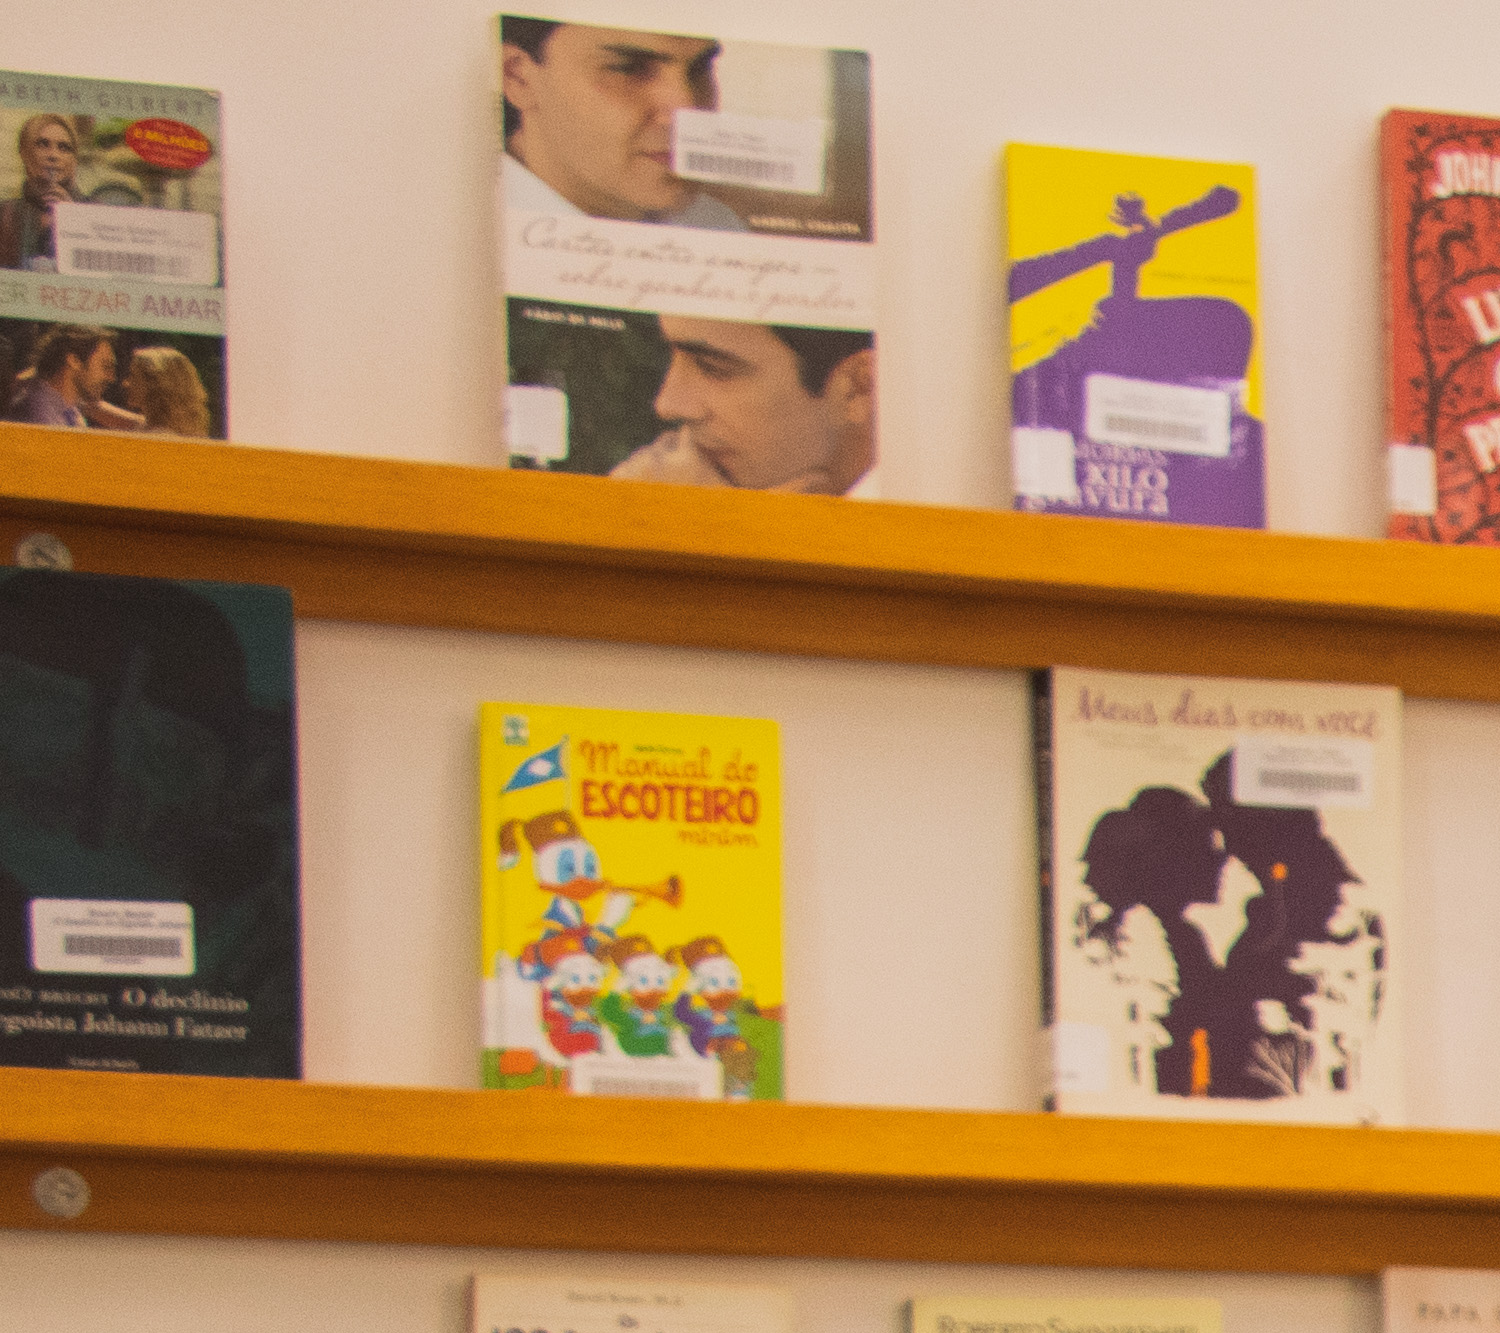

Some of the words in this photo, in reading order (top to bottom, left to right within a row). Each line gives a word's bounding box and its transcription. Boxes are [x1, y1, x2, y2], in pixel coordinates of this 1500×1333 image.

[38, 284, 132, 314] REZAR
[140, 293, 222, 321] AMAR
[576, 738, 713, 779] Manual
[580, 777, 761, 828] ESCOTEIRO
[1415, 1301, 1482, 1323] PAPA
